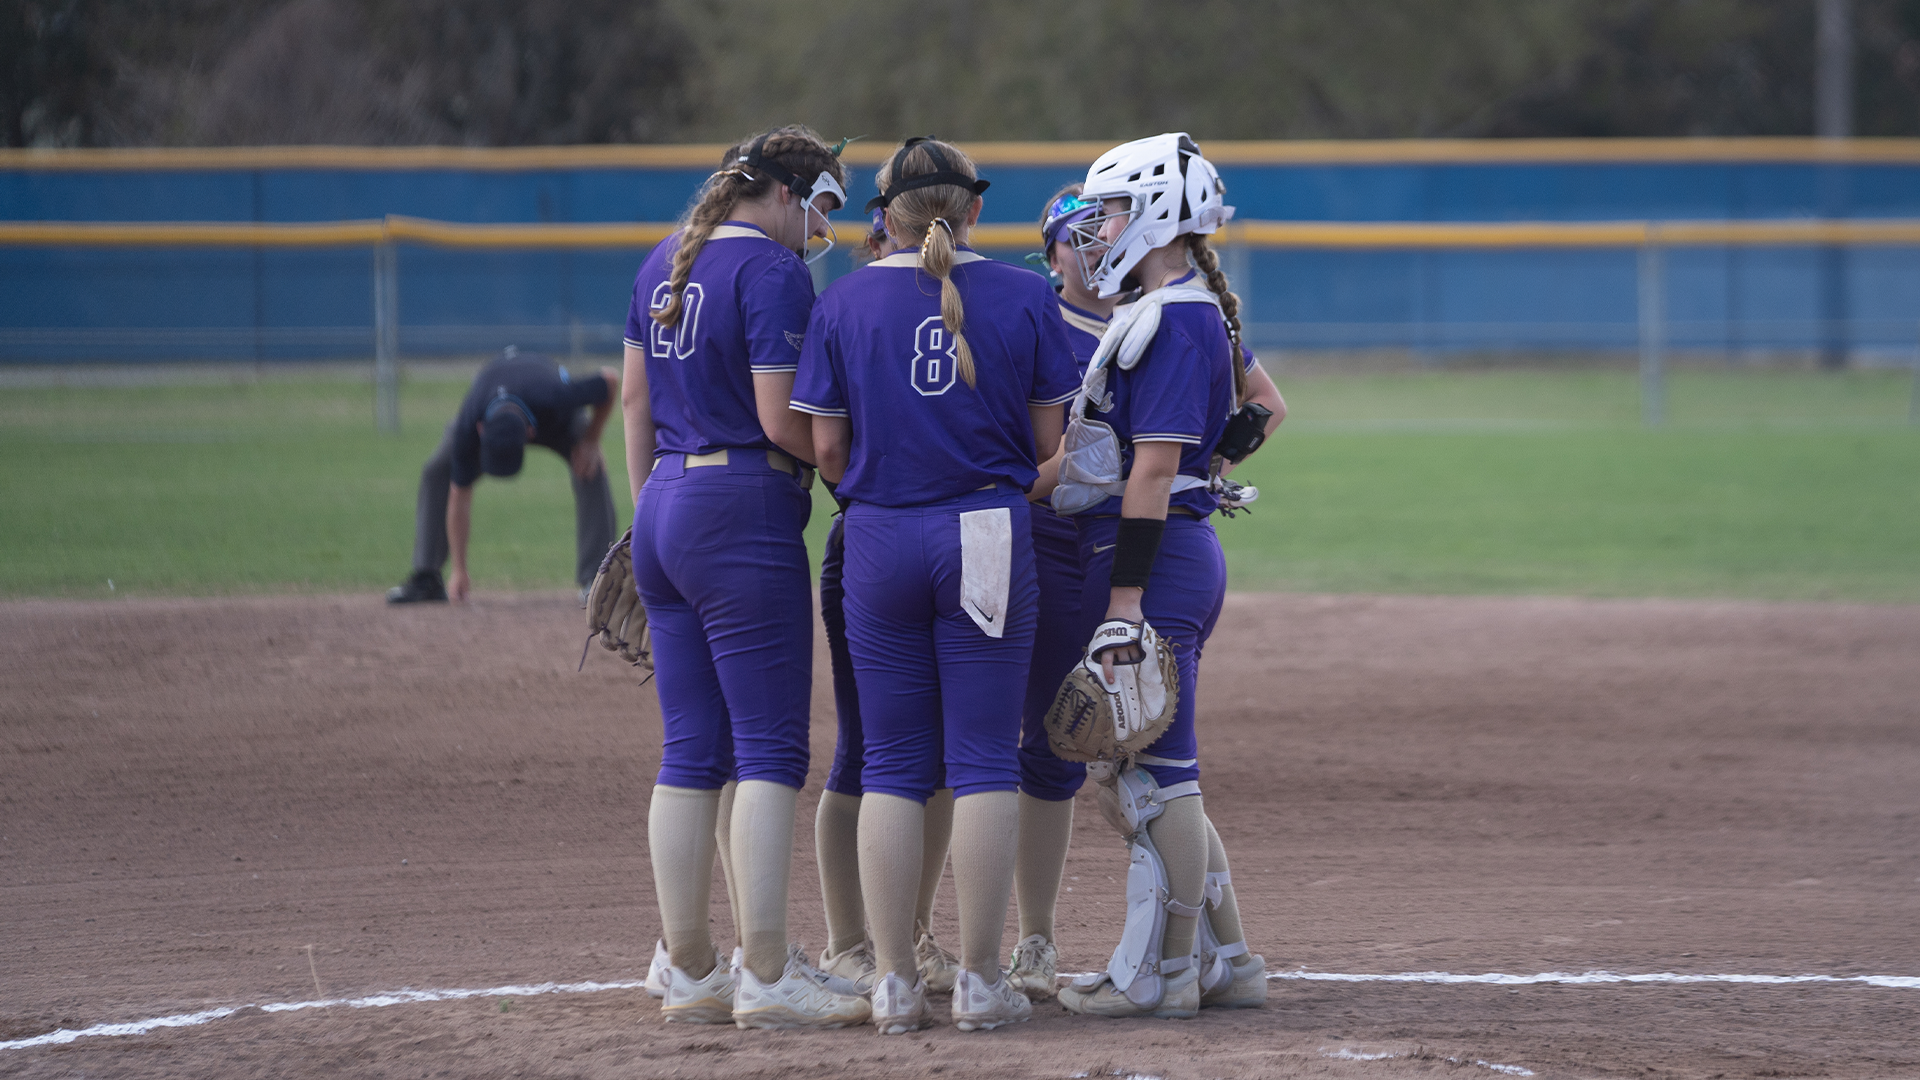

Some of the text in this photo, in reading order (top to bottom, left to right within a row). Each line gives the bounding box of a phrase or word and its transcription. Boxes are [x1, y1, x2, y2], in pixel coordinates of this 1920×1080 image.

[1139, 180, 1169, 188] EASTON
[651, 281, 704, 359] 20
[911, 316, 957, 396] 8
[1114, 693, 1126, 730] A2000
